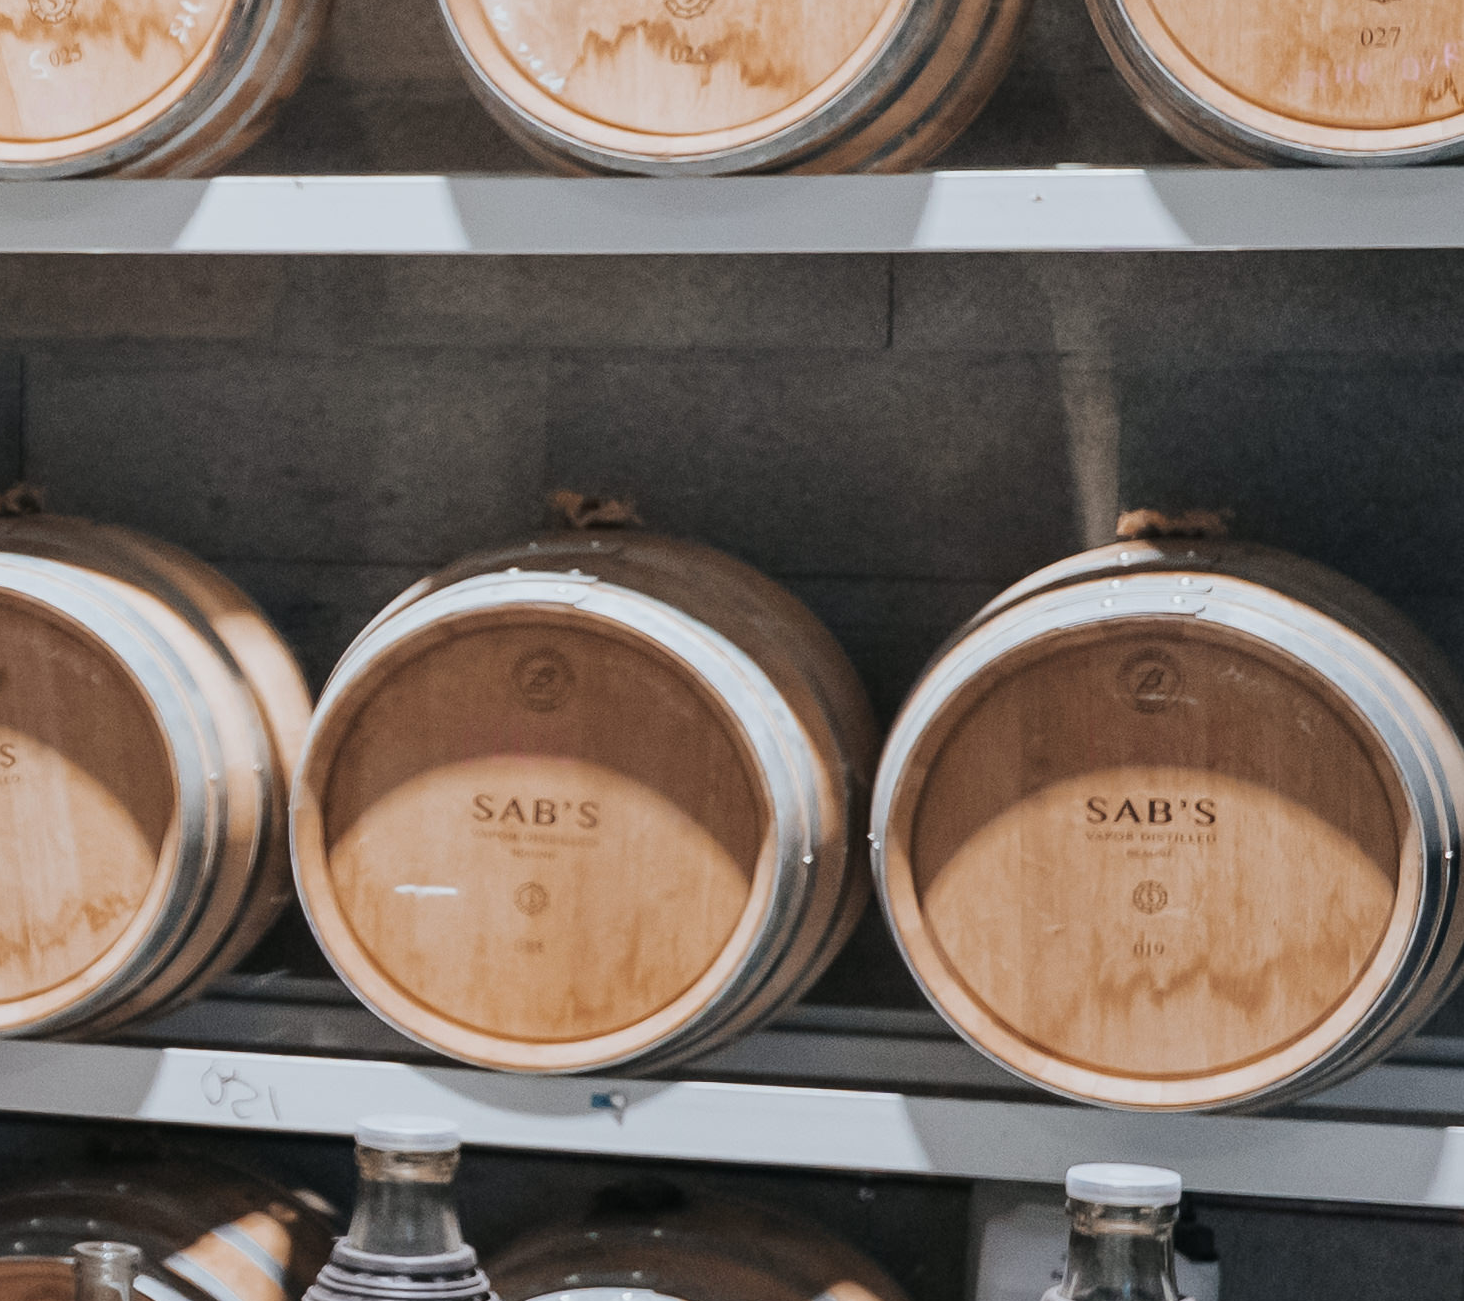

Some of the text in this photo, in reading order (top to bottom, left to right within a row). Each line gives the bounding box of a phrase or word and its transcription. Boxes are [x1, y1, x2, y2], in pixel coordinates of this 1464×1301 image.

[1360, 26, 1401, 49] 027
[49, 42, 83, 68] 025
[471, 793, 600, 830] SAB'S
[1085, 795, 1217, 827] SAB'S
